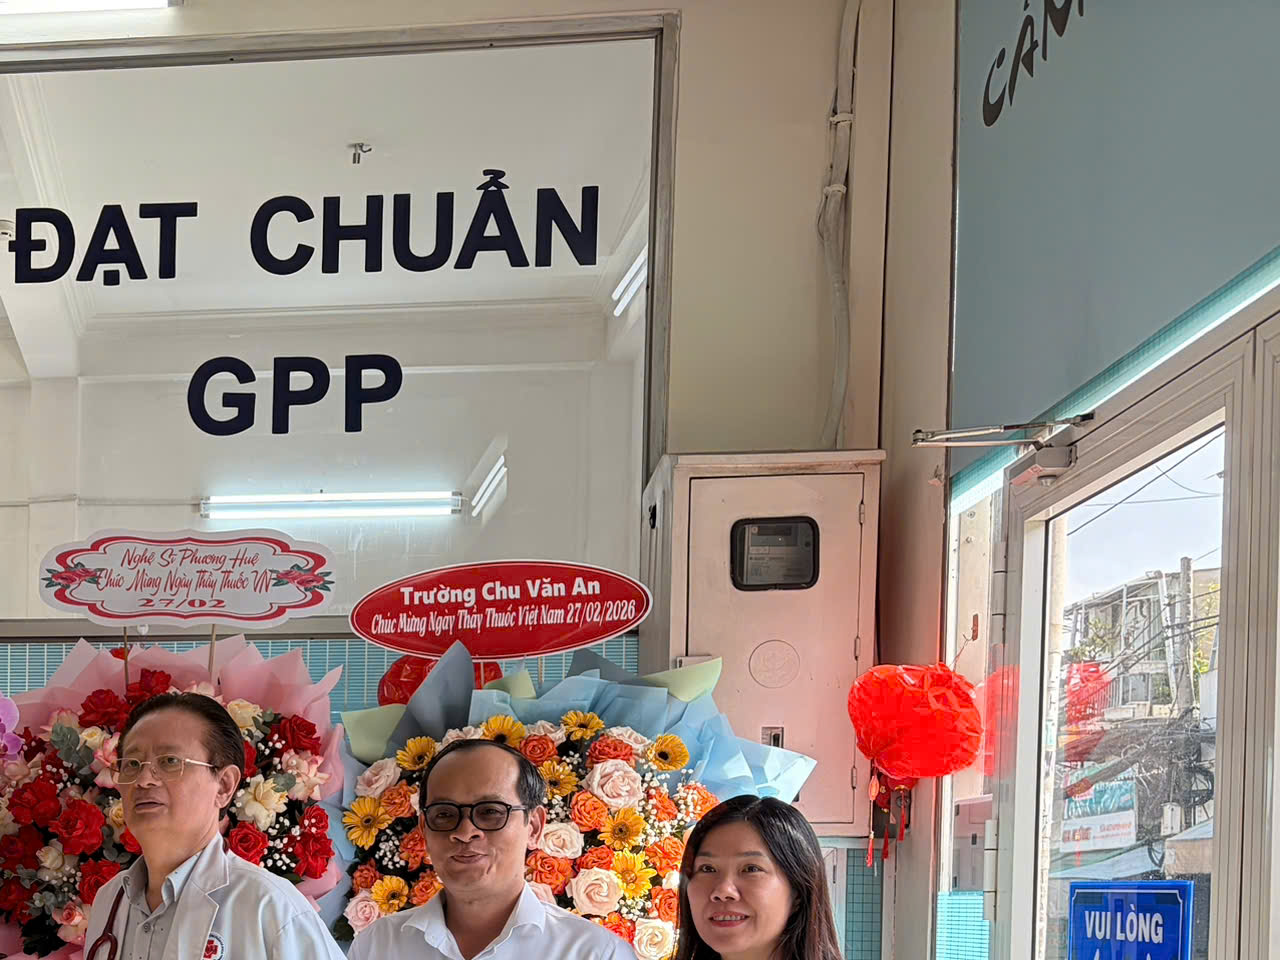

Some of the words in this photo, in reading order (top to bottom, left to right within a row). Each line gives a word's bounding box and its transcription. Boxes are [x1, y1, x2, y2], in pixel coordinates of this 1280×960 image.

[8, 202, 198, 286] ĐẠT
[250, 169, 599, 276] CHUẨN
[187, 354, 403, 437] GPP
[120, 546, 156, 570] Nghệ
[178, 546, 227, 571] Phương
[229, 547, 260, 569] Huệ
[96, 567, 124, 591] Chúc
[125, 568, 162, 597] Mừng
[163, 567, 194, 598] Ngày
[195, 568, 218, 599] Thầy
[219, 569, 249, 593] Thuốc
[250, 568, 274, 594] VN
[400, 583, 476, 607] Trường
[482, 581, 520, 601] Chu
[526, 577, 566, 598] Văn
[571, 576, 601, 596] An
[138, 597, 226, 609] 27/02
[371, 611, 397, 634] Chúc
[397, 610, 427, 637] Mừng
[428, 608, 455, 636] Ngày
[457, 604, 483, 634] Thầy
[485, 603, 516, 628] Thuốc
[518, 604, 538, 631] Việt
[539, 603, 564, 625] Nam
[566, 599, 636, 628] 27/02/2026
[1084, 910, 1111, 940] VUI
[1115, 903, 1164, 944] LÒNG
